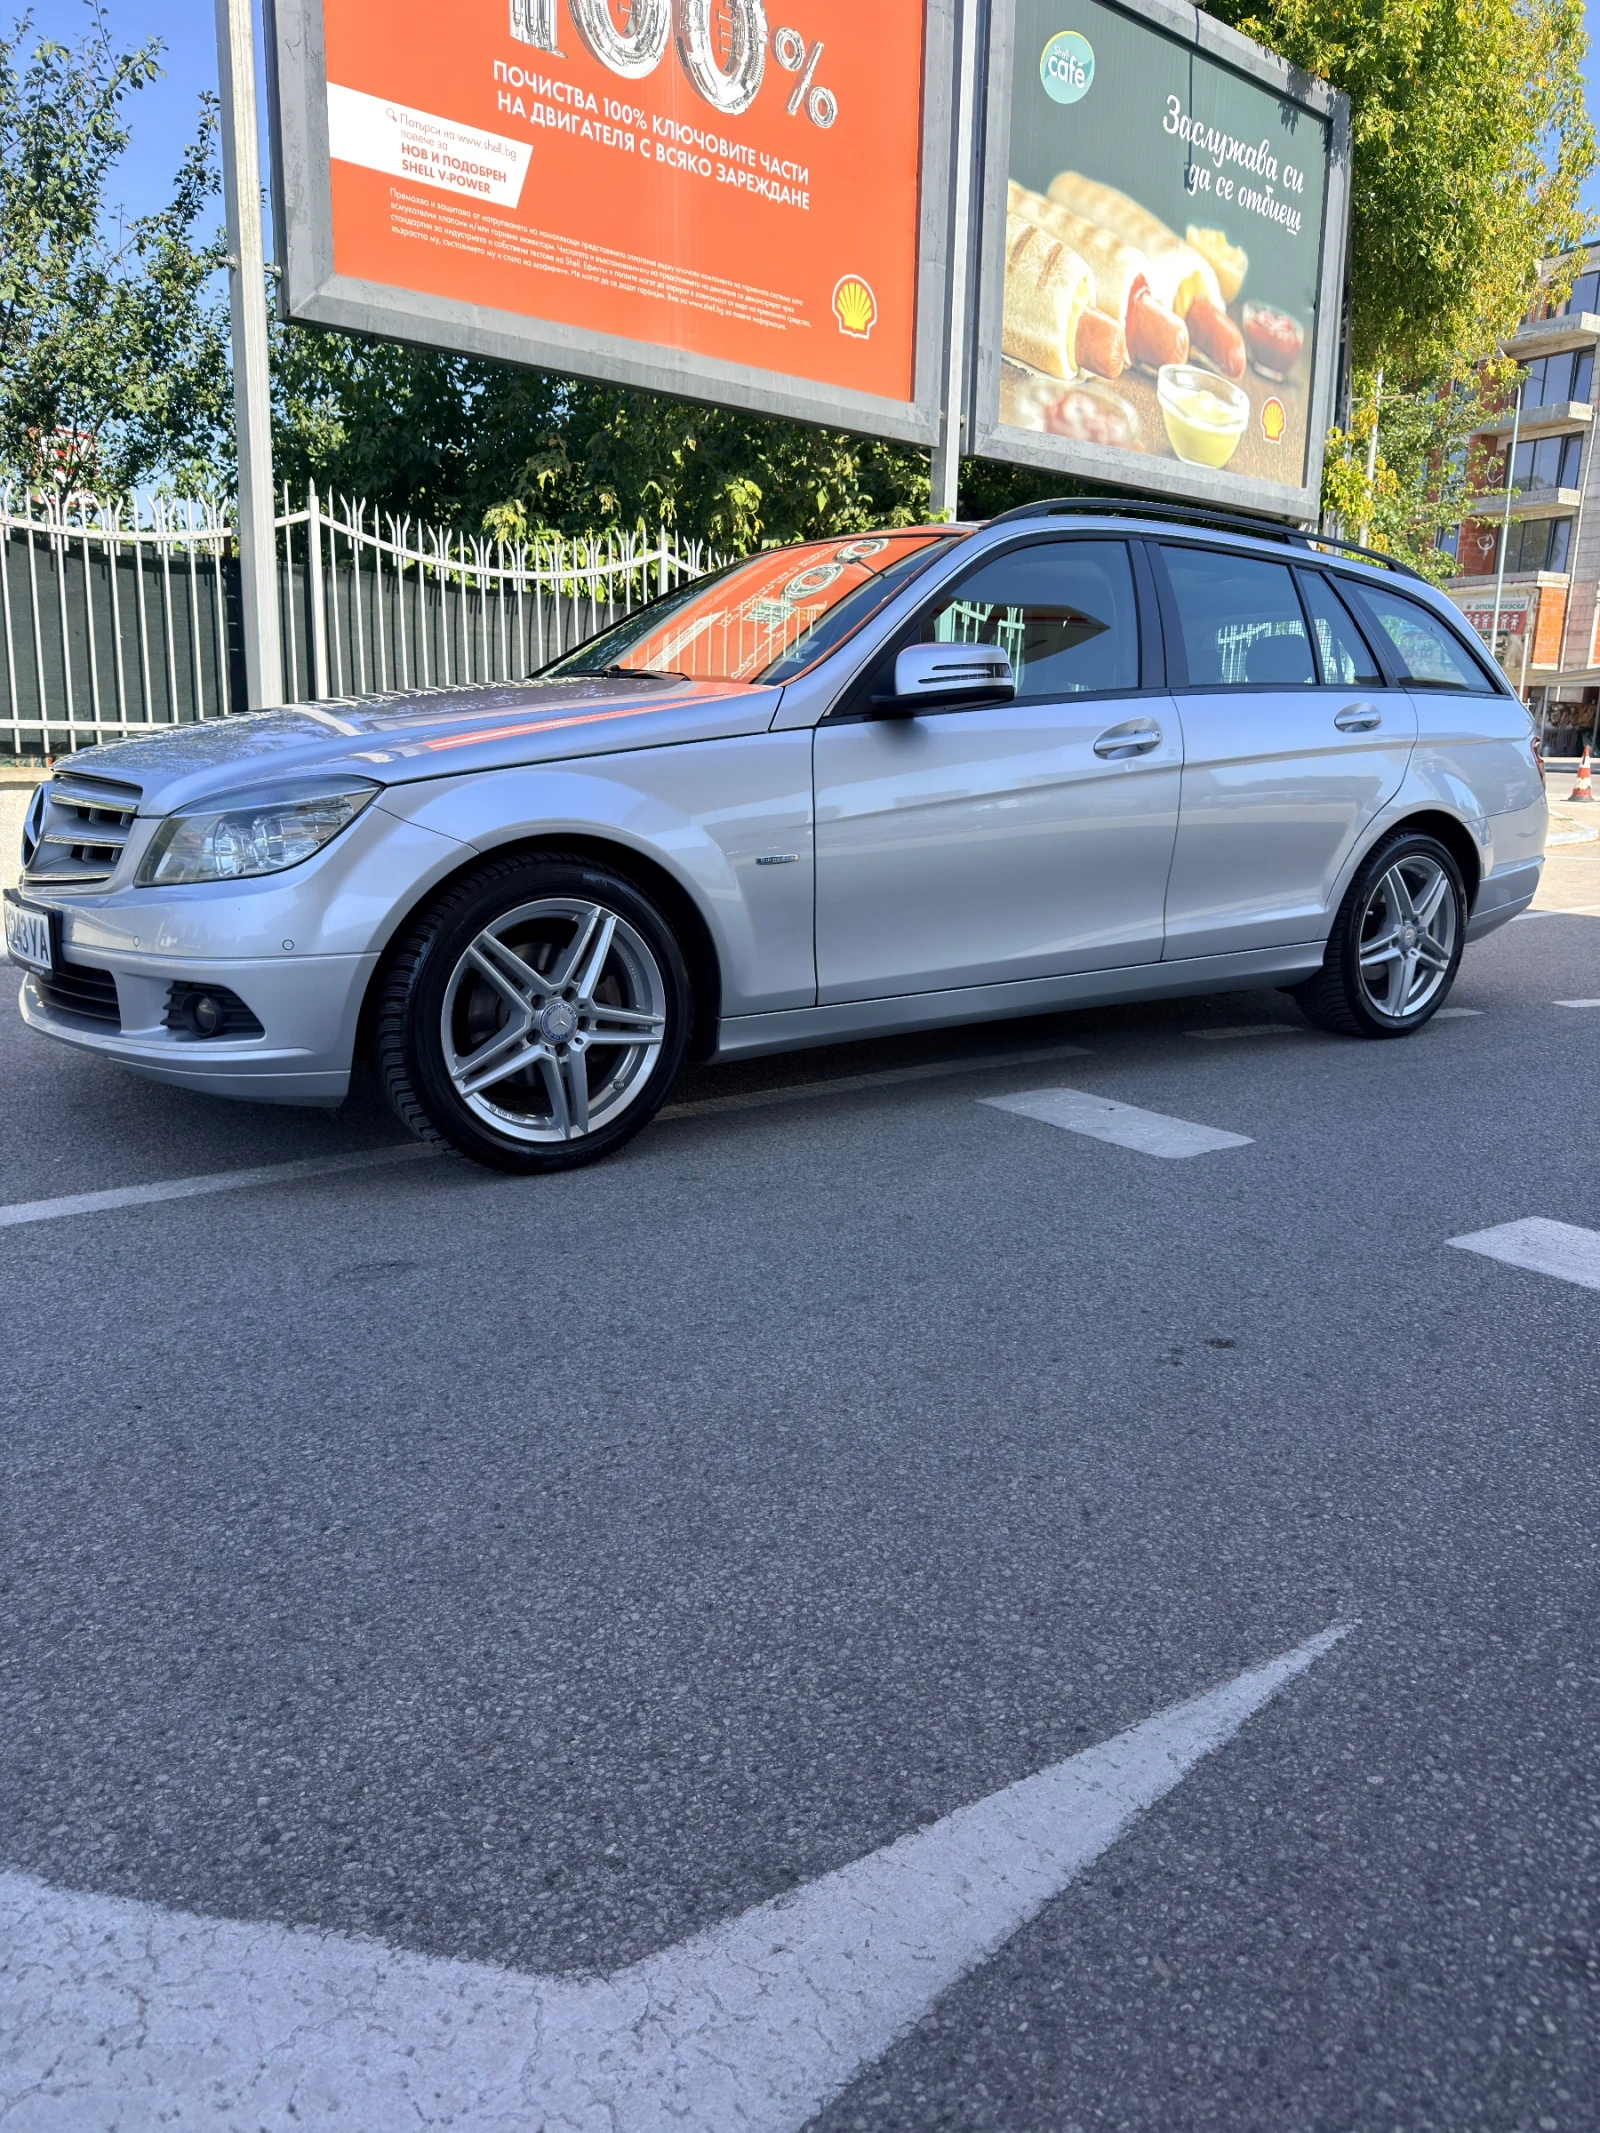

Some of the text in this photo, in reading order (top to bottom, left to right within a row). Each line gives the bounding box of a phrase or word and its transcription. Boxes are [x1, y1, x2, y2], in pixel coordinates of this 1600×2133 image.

[1048, 56, 1085, 88] café
[400, 113, 441, 136] Потърси
[493, 60, 810, 185] ПОЧИСТВА 100% КЛЮЧОВИТЕ ЧАСТИ
[498, 91, 810, 210] НА ДВИГАТЕЛЯ С ВСЯКО ЗАРЕЖДАНЕ
[1163, 94, 1304, 193] Заслужава си
[401, 142, 507, 183] НОВ И ПОДОБРЕН
[402, 159, 491, 194] SHELL V-POWER
[1187, 163, 1302, 235] да се отбиеш
